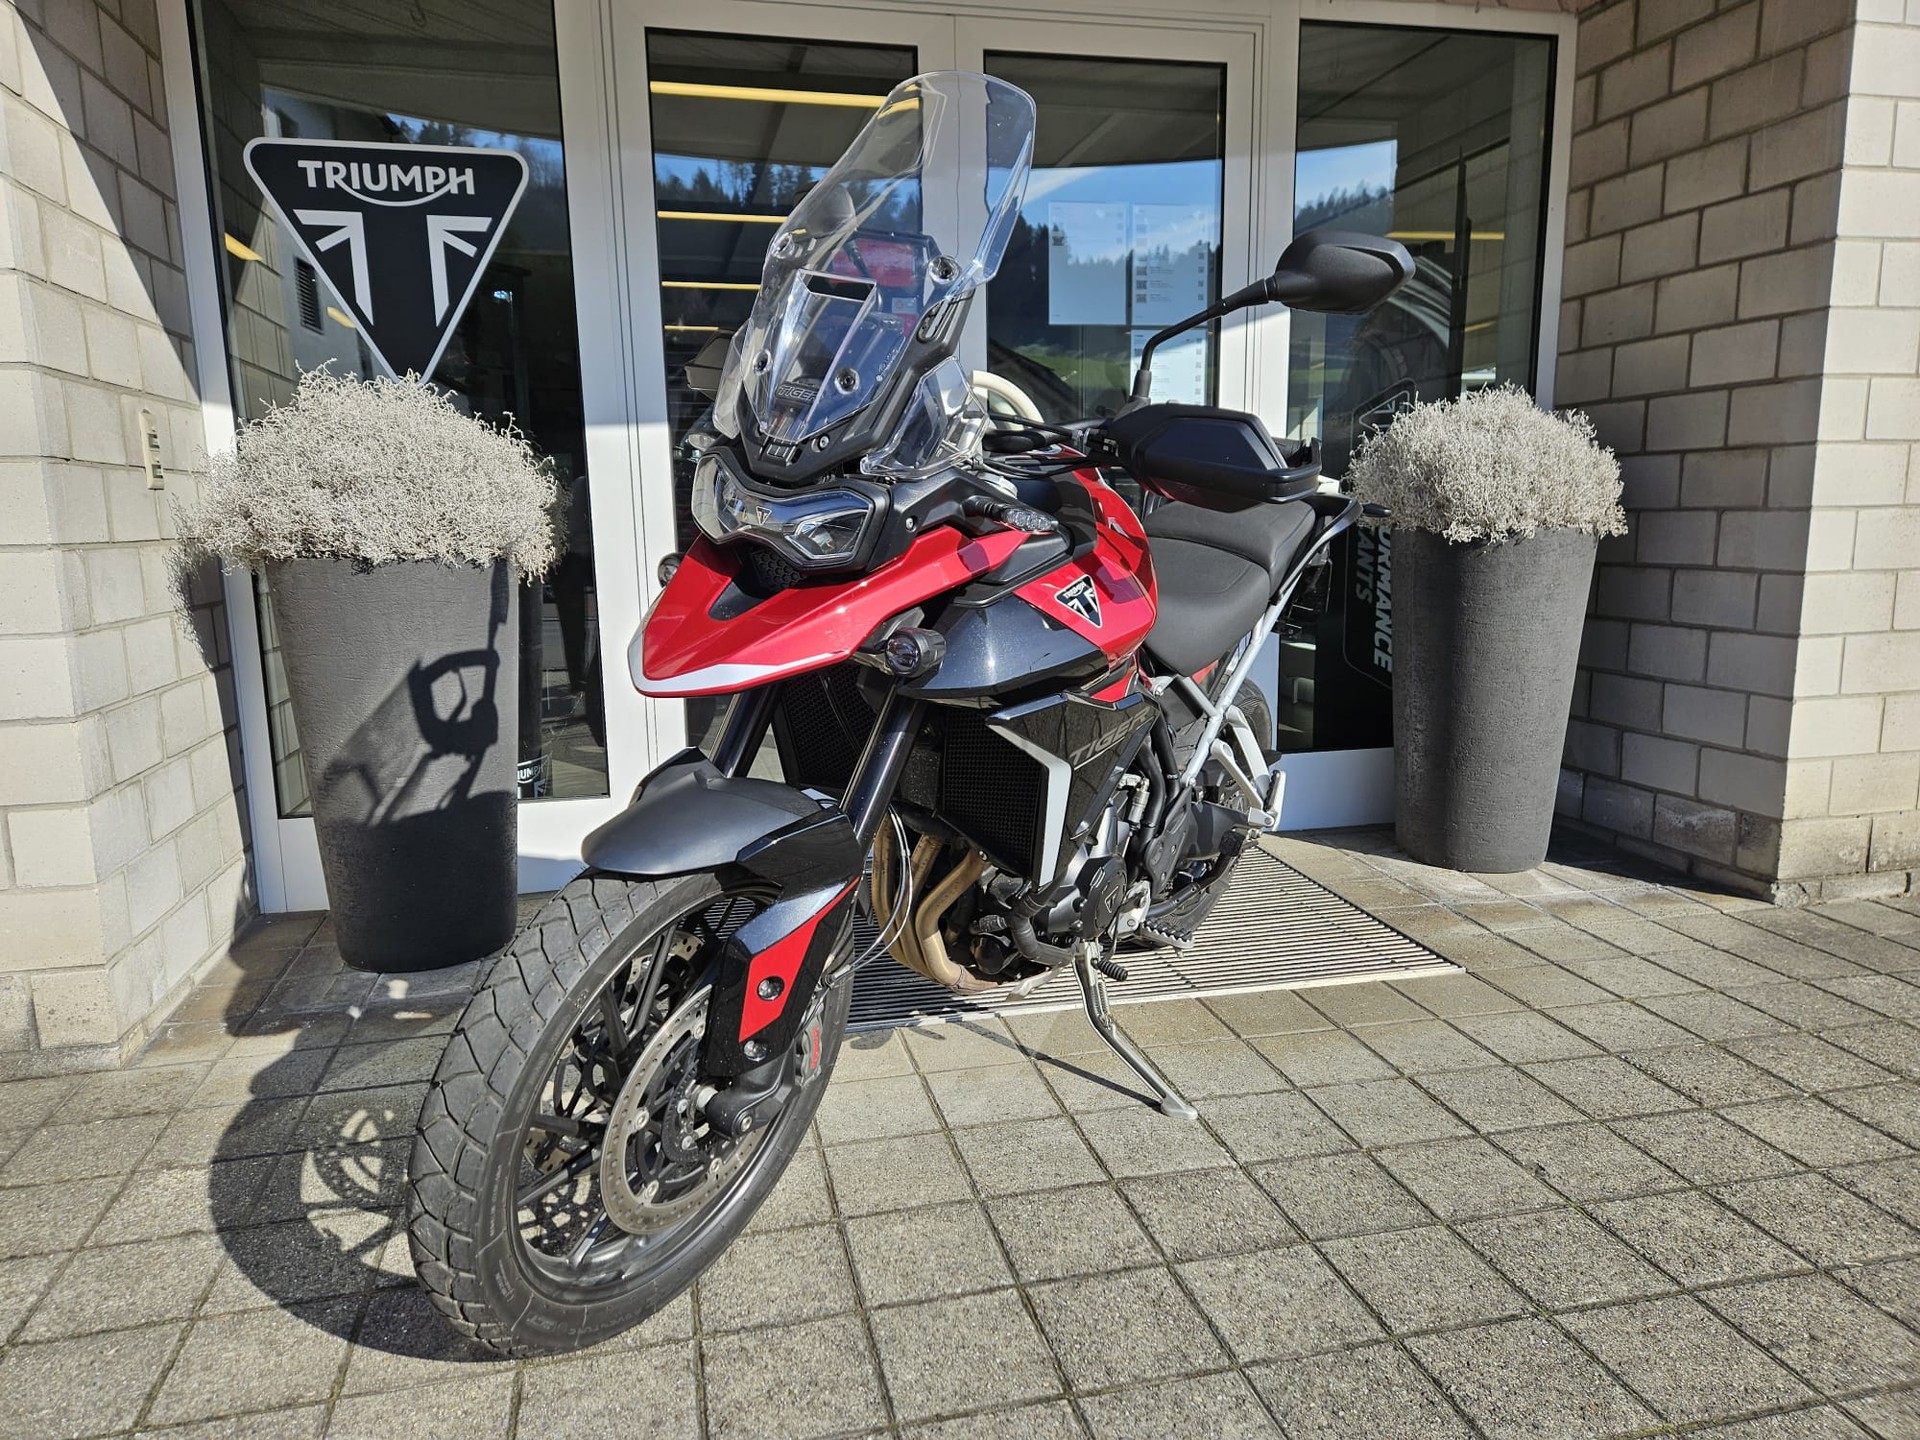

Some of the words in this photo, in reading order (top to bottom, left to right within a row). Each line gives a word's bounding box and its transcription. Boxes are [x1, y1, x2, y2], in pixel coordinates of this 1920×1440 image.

[298, 160, 475, 206] TRIUMPH
[778, 385, 818, 401] TIGER
[1356, 527, 1376, 604] ANTS
[1069, 706, 1151, 765] TIGER
